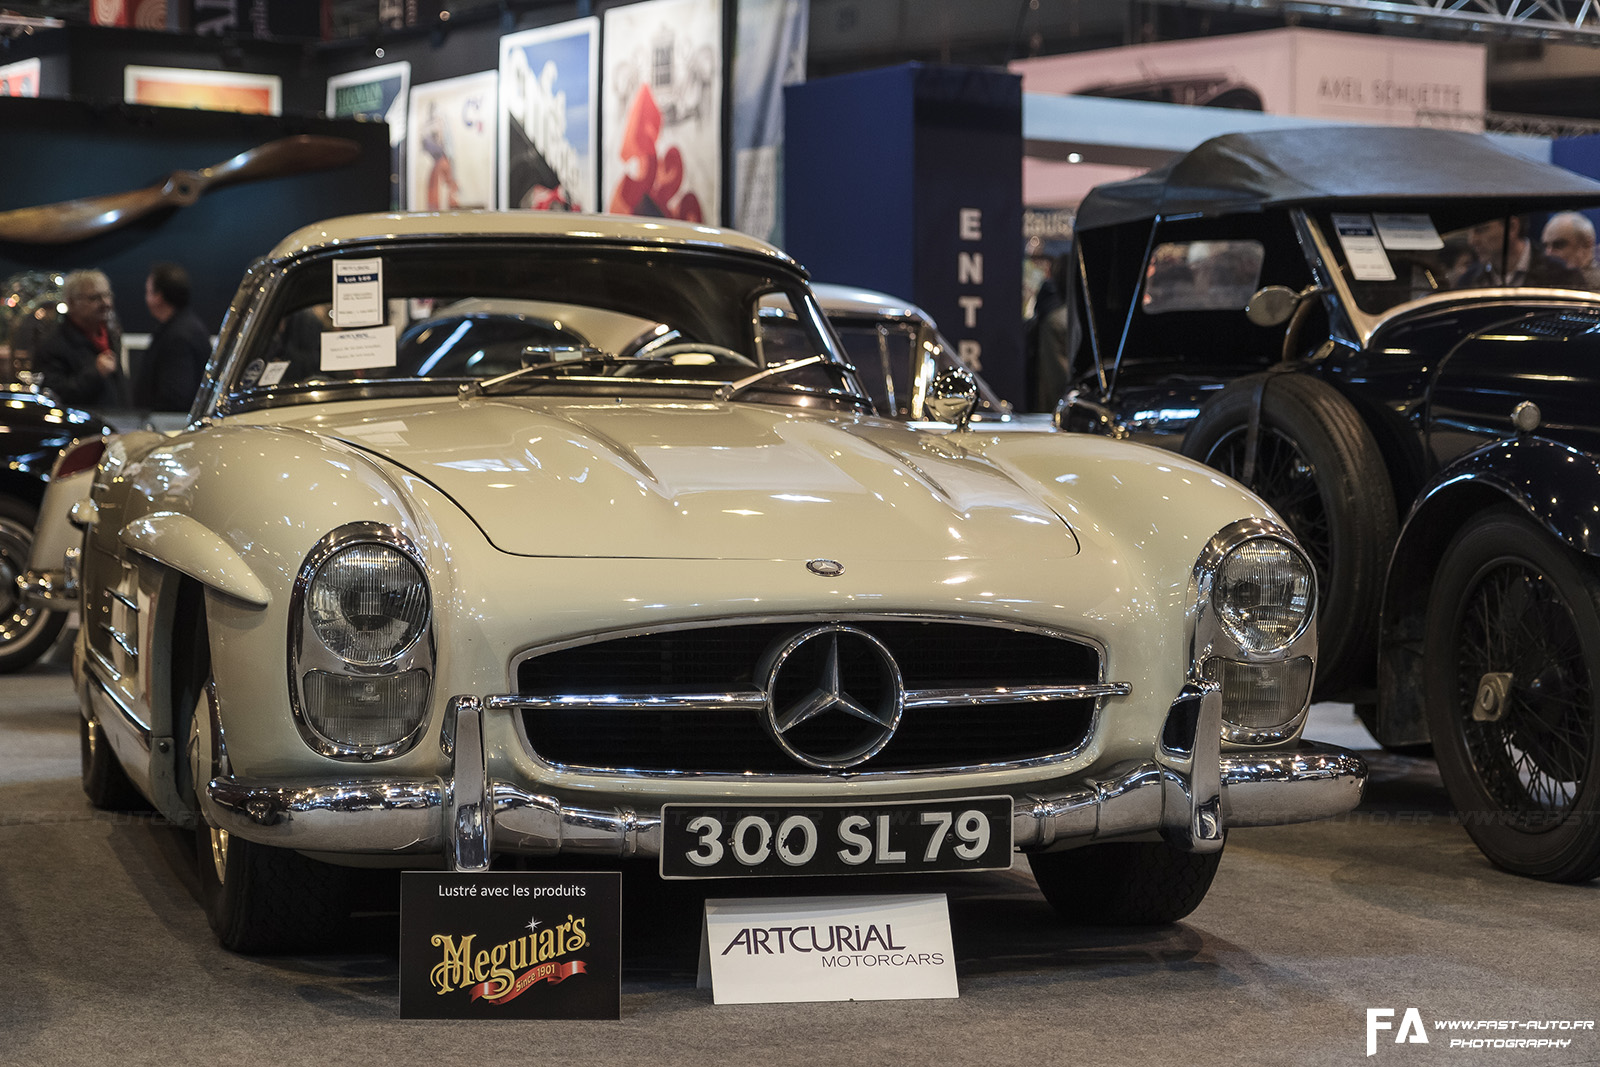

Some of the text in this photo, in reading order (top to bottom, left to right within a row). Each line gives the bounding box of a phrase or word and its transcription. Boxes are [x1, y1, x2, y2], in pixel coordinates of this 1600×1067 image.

[1317, 76, 1363, 102] AXEL
[685, 810, 990, 866] 300 SL 79
[438, 884, 586, 899] Lustré avec les produits
[430, 914, 587, 1000] Meguiar's
[821, 952, 944, 968] MOTORCARS
[515, 964, 555, 992] Since 1901
